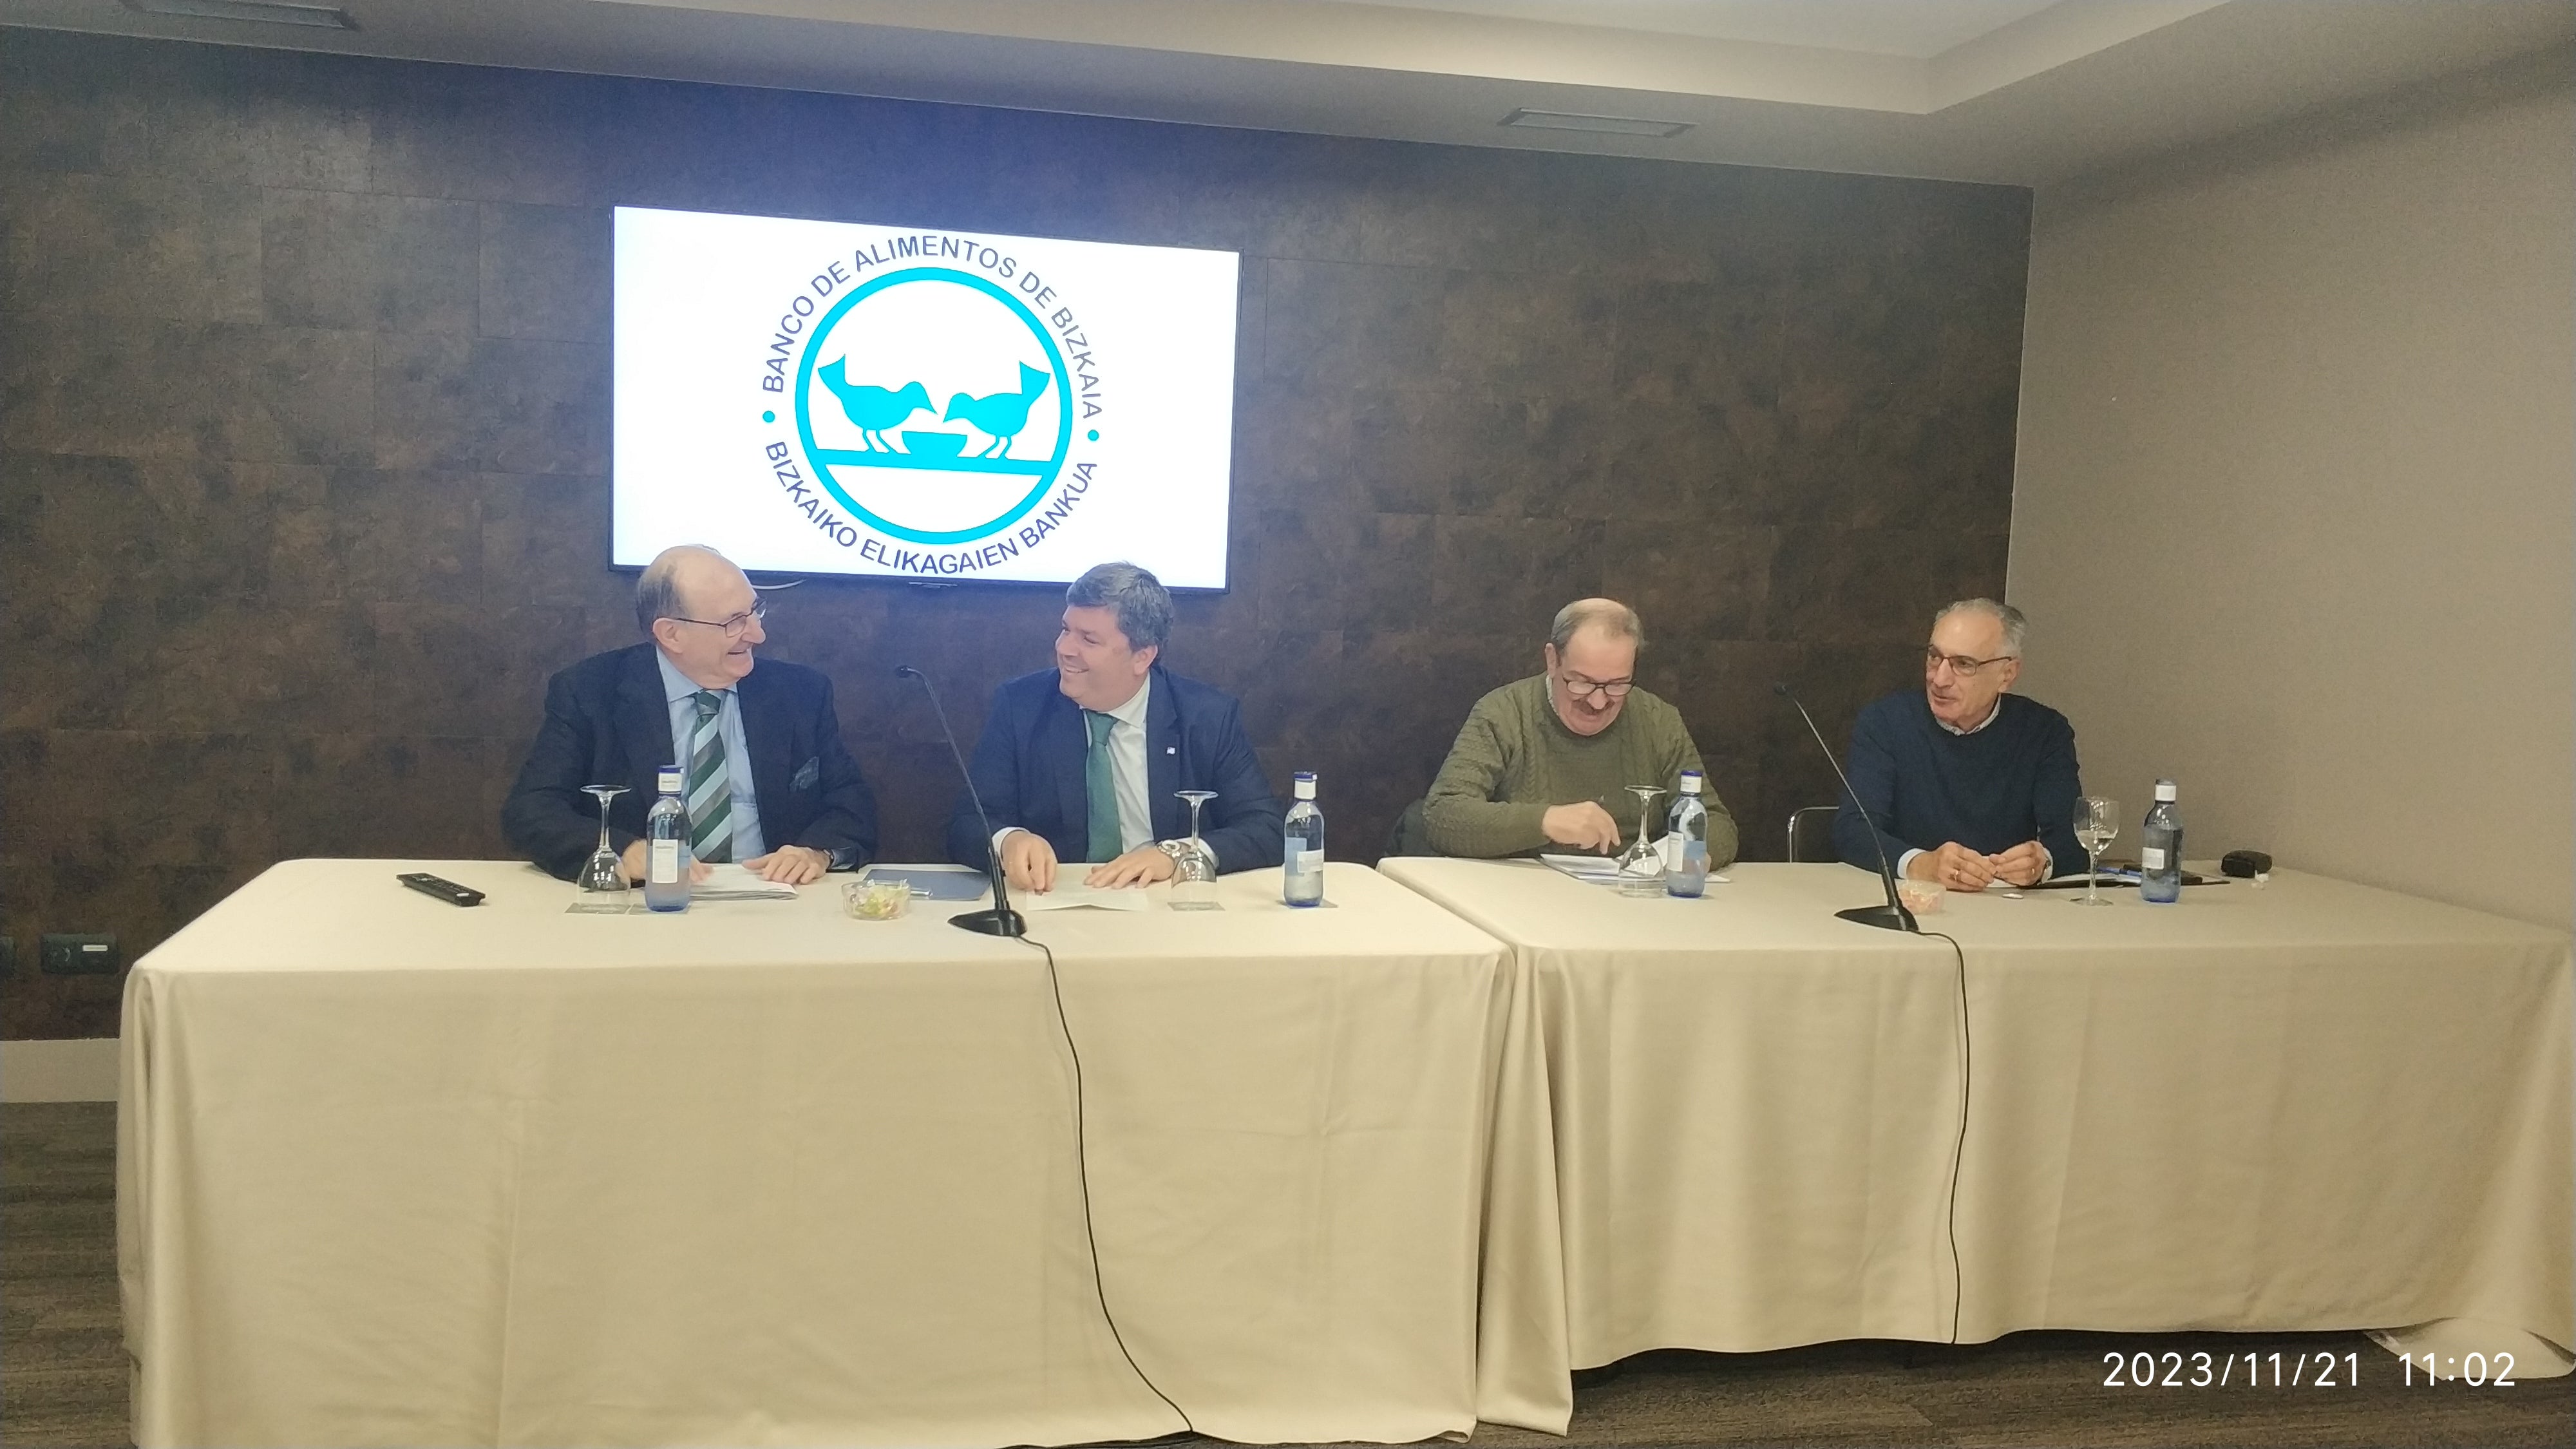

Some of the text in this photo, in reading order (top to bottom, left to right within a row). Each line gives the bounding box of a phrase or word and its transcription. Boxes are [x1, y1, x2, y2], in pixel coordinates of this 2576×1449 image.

[762, 235, 1103, 419] BANCO DE ALIMENTOS DE BIZKAIA
[765, 441, 1098, 574] BIZKAIKO ELIKAGAIEN BANKUA
